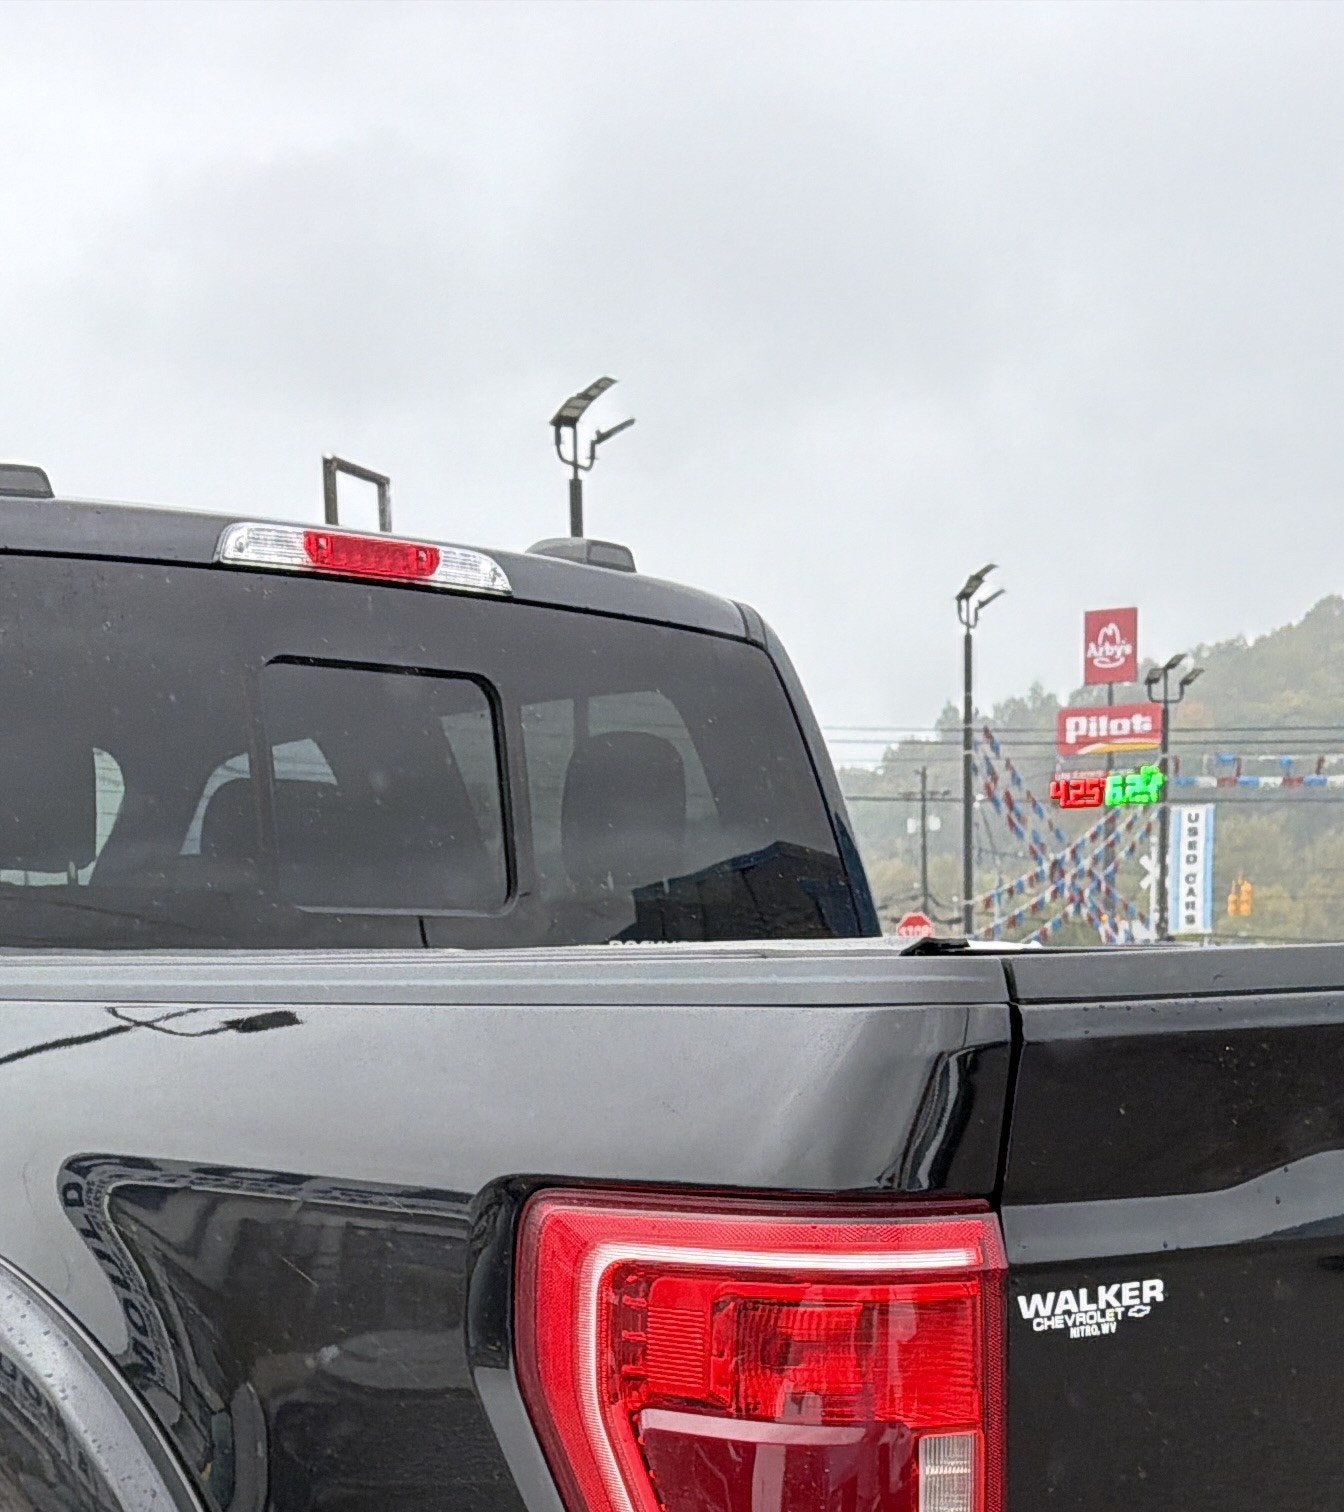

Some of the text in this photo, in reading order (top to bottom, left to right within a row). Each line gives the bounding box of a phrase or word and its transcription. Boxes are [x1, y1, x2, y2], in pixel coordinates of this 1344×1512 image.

[1065, 714, 1153, 744] Pilot
[1186, 813, 1200, 865] USED
[1017, 1279, 1165, 1319] WALKER
[1032, 1307, 1125, 1332] CHEVROLET
